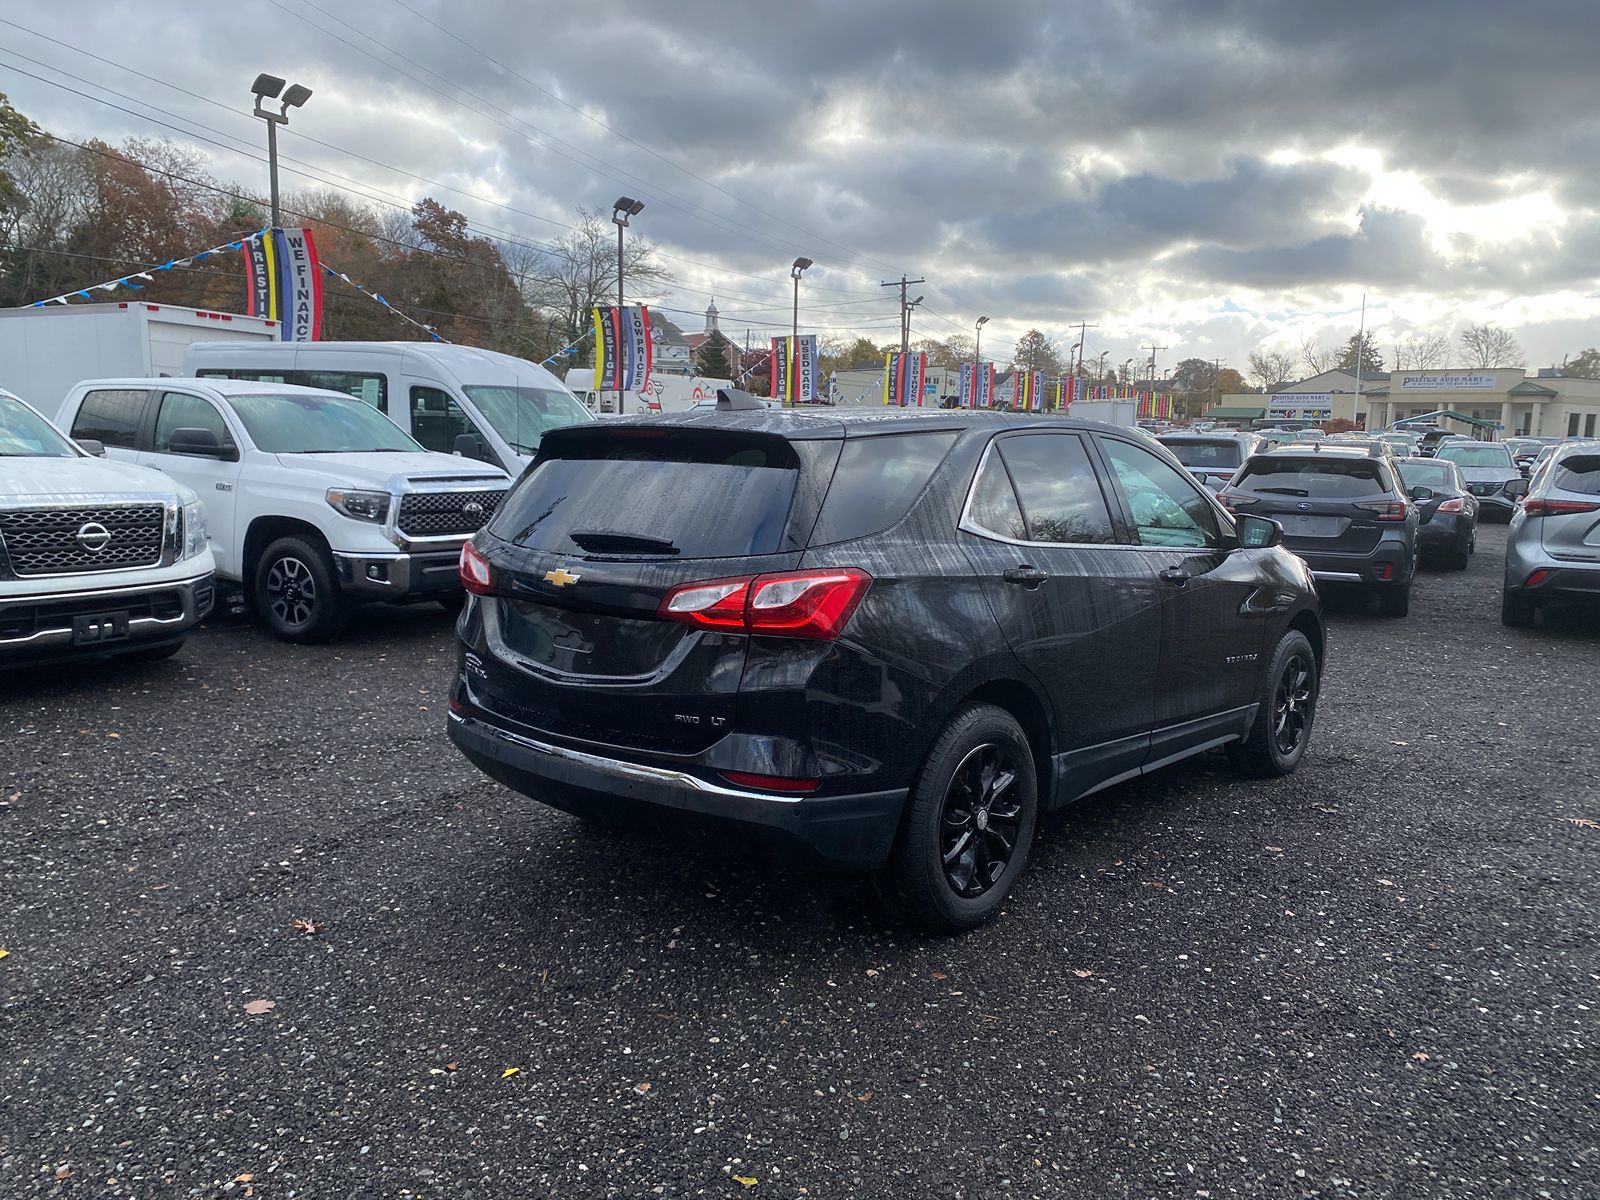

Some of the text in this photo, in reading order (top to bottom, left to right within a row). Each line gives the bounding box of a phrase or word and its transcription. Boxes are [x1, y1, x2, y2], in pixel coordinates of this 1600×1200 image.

[287, 237, 310, 342] WE FINANC
[602, 311, 615, 377] PRESTIGE
[633, 312, 645, 385] LOW PRICES
[801, 339, 810, 397] USED CARS
[1403, 377, 1437, 386] PRESTIGE
[711, 716, 726, 726] LT
